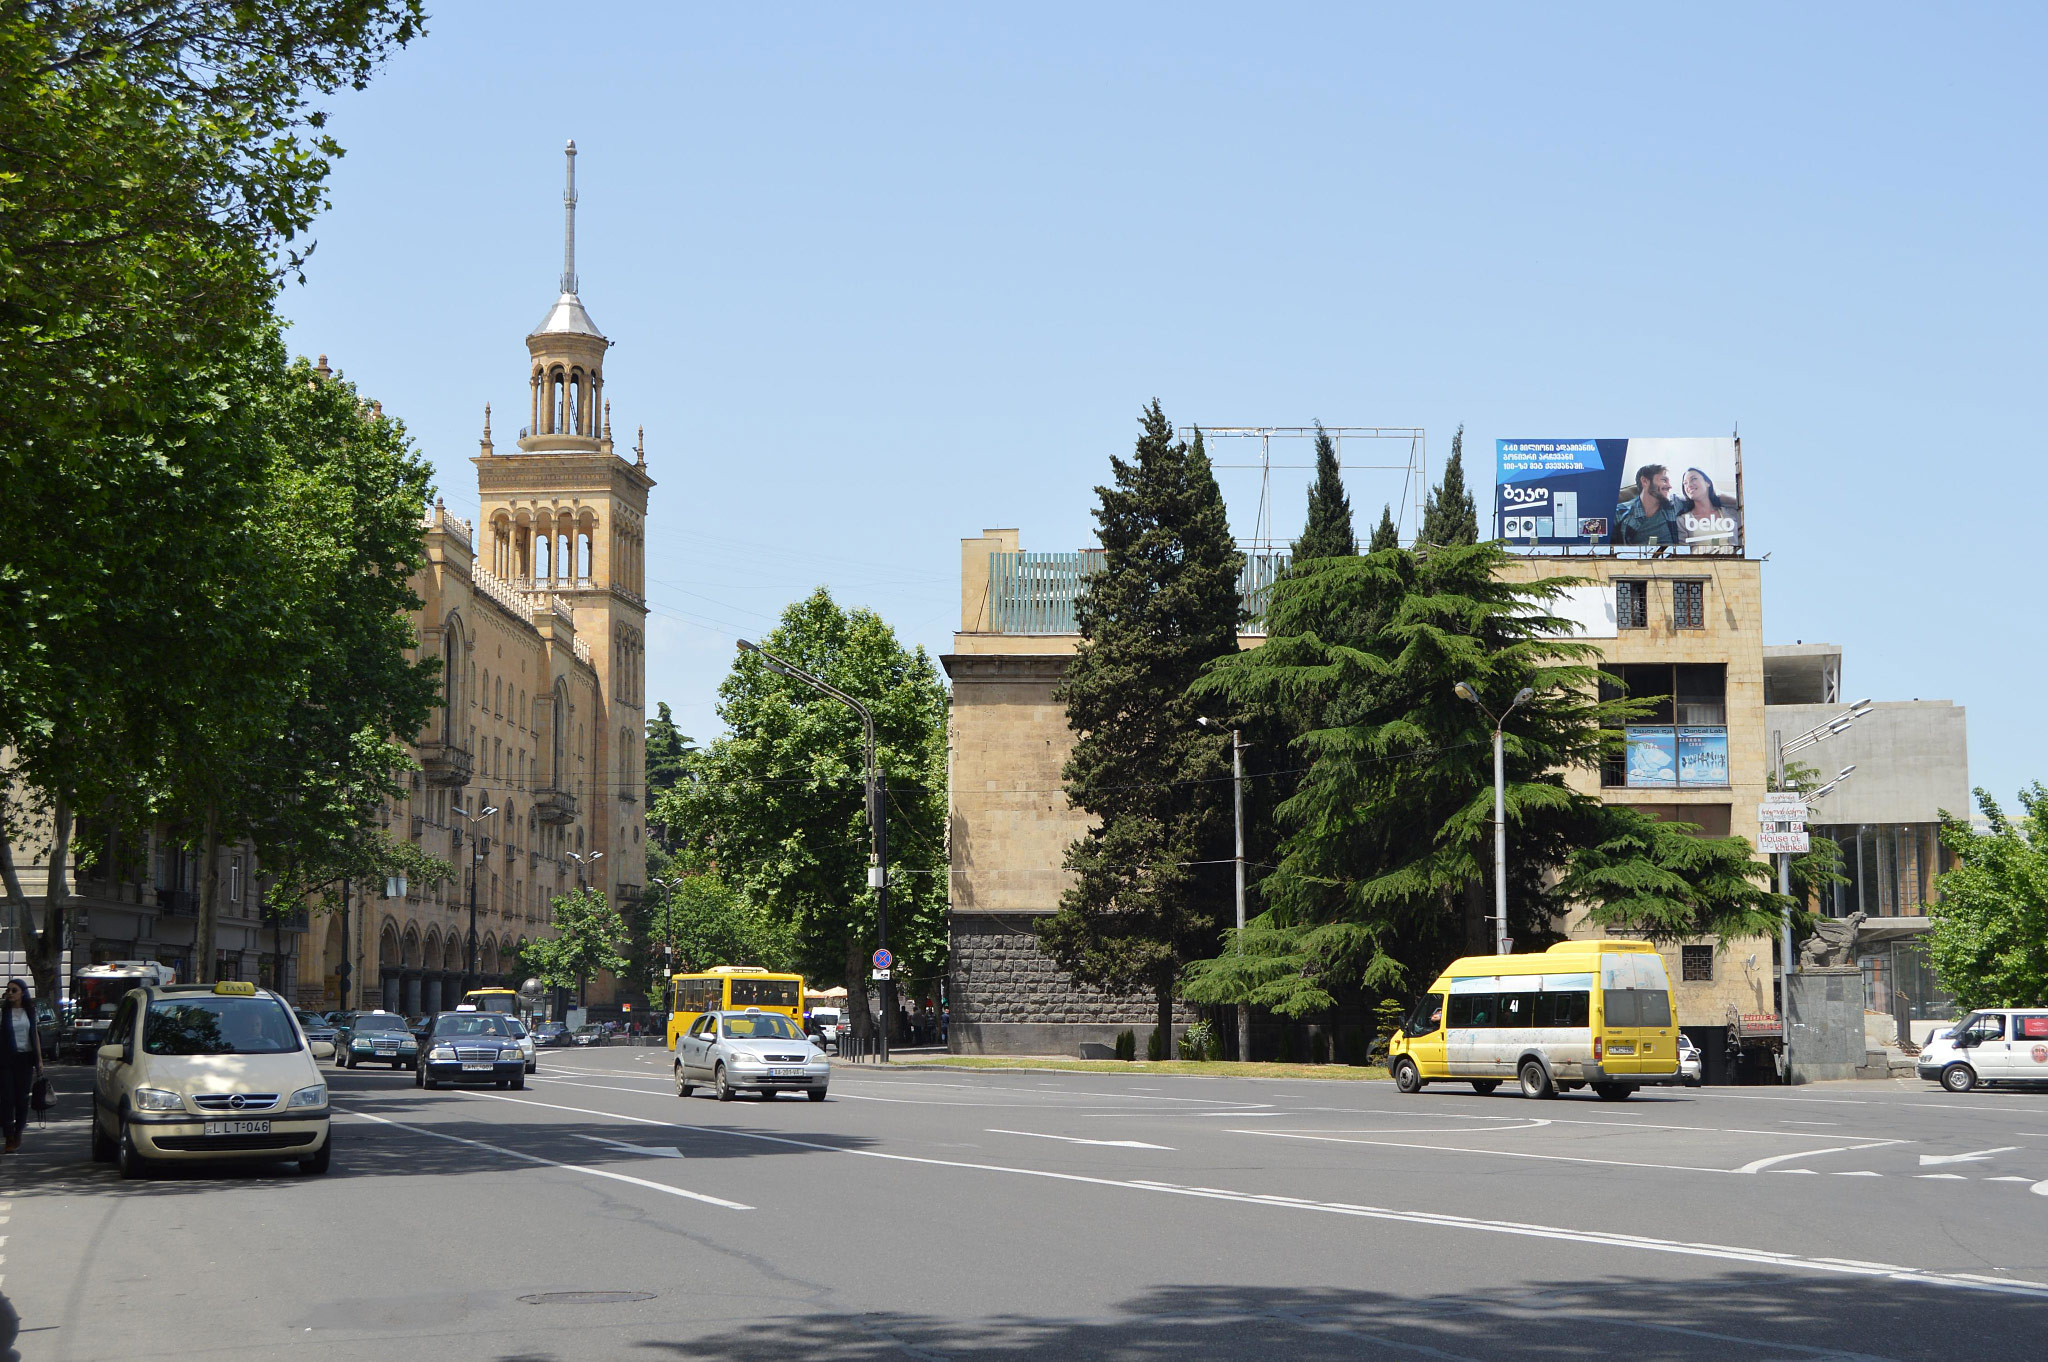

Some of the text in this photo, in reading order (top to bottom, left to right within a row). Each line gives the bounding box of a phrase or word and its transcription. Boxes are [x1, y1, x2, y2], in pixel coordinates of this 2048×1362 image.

[1503, 484, 1549, 502] ბეკო
[1685, 514, 1735, 532] beko
[1792, 823, 1802, 831] 24
[1760, 834, 1788, 843] House
[1509, 999, 1519, 1013] 41
[213, 1122, 269, 1134] LLT-046
